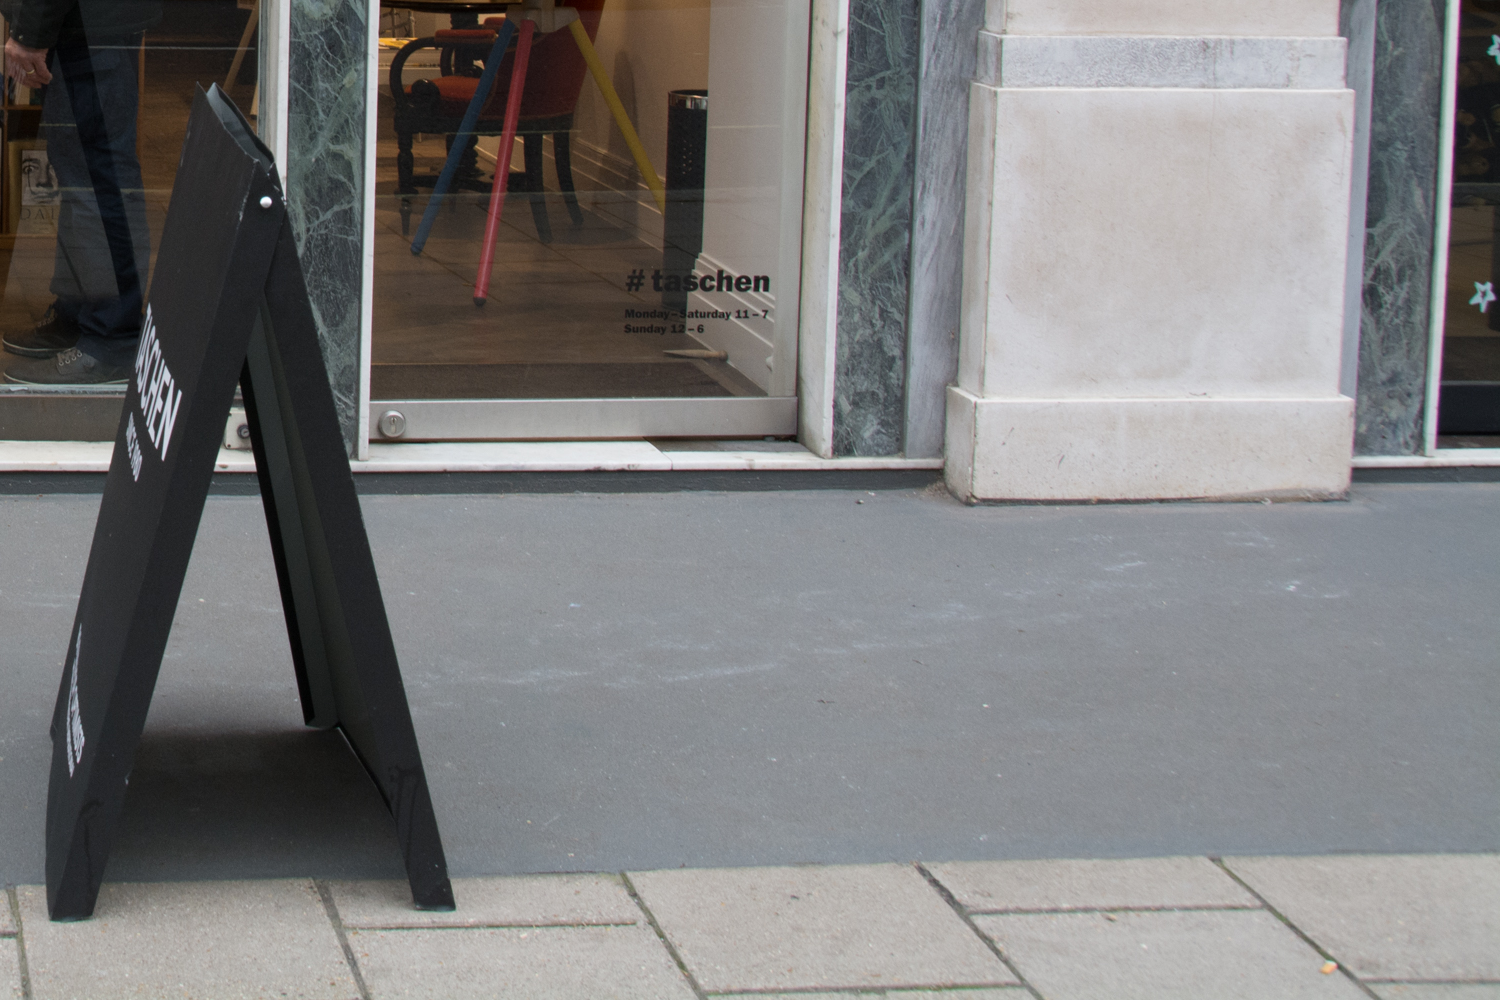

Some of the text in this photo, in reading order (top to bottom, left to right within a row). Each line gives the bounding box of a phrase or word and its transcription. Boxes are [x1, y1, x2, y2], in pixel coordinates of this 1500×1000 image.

[651, 269, 770, 292] taschen
[735, 309, 750, 319] 11
[761, 309, 769, 319] 7
[624, 324, 667, 335] Sunday
[670, 324, 685, 333] 12
[697, 324, 704, 333] 6
[135, 302, 182, 462] TASCHEN
